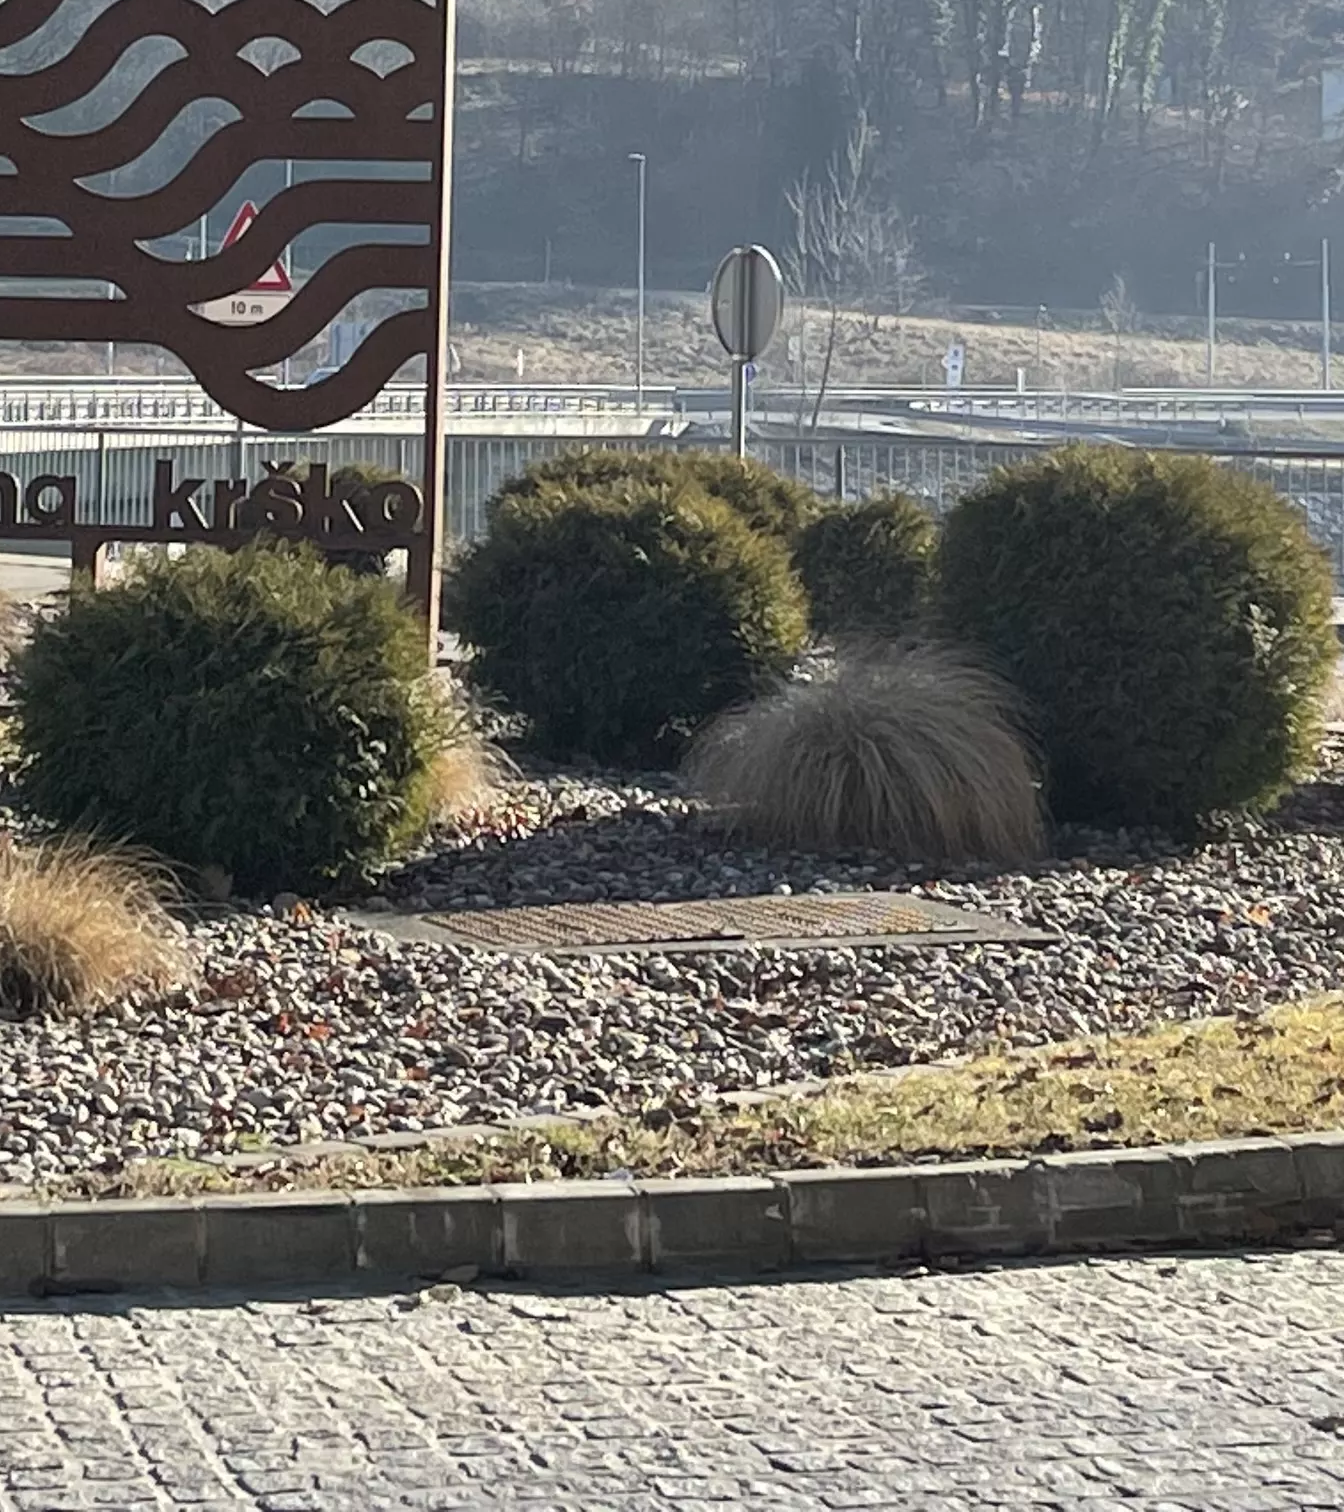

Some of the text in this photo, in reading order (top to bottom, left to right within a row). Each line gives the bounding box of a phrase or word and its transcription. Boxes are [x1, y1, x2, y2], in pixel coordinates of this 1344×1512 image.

[231, 300, 264, 315] 10 m
[156, 459, 424, 534] krško
